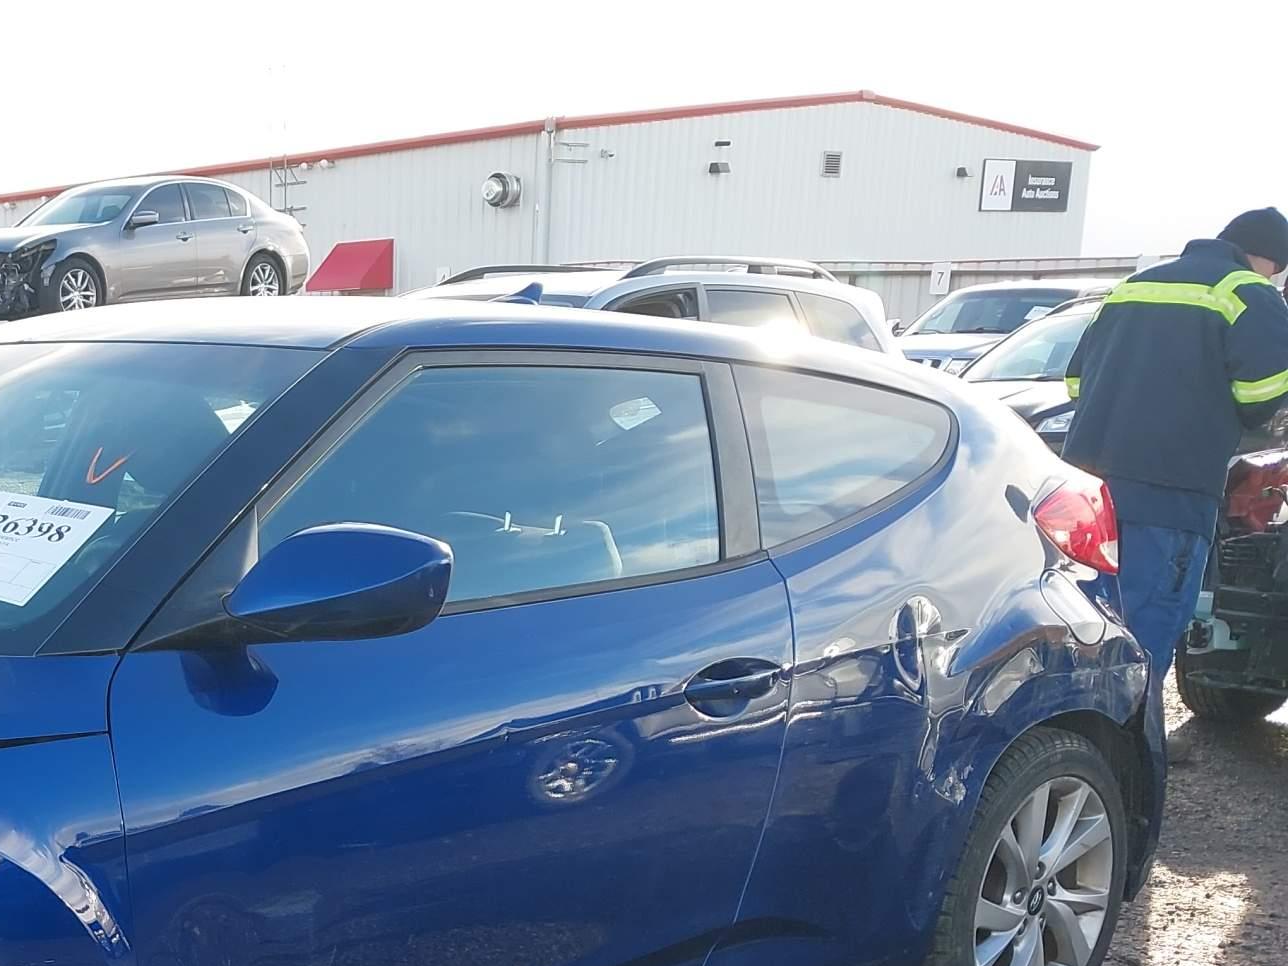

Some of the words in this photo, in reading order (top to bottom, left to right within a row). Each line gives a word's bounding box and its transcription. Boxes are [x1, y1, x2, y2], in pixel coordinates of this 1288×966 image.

[1027, 174, 1056, 186] Insurance
[1021, 187, 1035, 199] Auto
[1035, 187, 1060, 199] Auctions
[937, 271, 945, 286] 7
